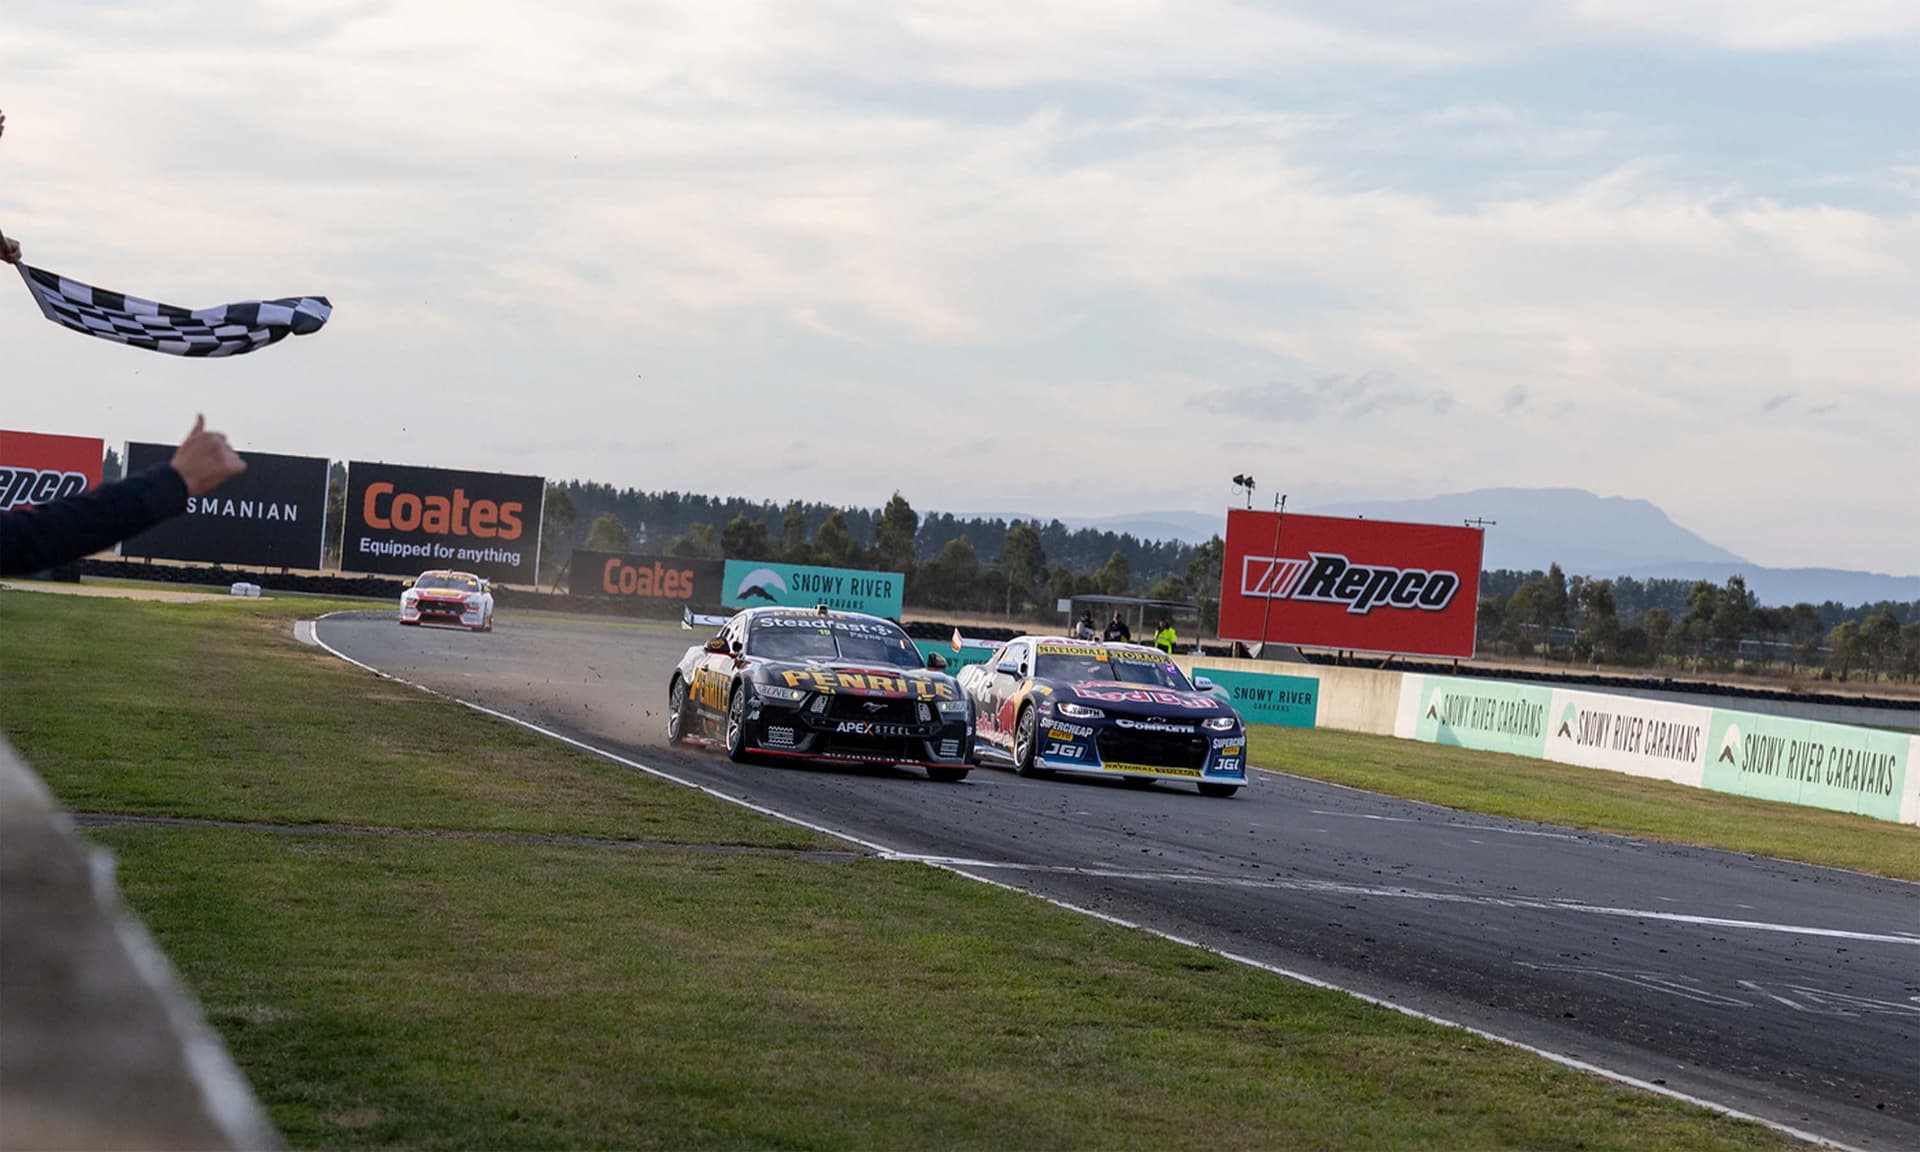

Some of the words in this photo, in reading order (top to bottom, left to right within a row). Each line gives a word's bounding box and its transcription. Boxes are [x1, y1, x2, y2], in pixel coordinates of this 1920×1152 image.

[363, 482, 523, 540] Coates
[360, 538, 431, 557] Equipped
[434, 544, 455, 559] for
[457, 548, 521, 566] anything
[603, 558, 694, 599] Coates
[792, 573, 844, 595] SNOWY
[850, 578, 892, 599] RIVER
[1294, 553, 1459, 612] Repco
[760, 617, 870, 633] Steadfast
[1039, 645, 1105, 657] NATIONAL
[689, 667, 729, 712] PENRITE
[781, 670, 954, 700] PENRITE
[1234, 687, 1273, 702] SNOWY
[1279, 691, 1312, 705] RIVER
[1254, 703, 1289, 712] CARAVANS
[1442, 694, 1471, 727] SNOWY
[1471, 697, 1497, 731] RIVER
[1497, 701, 1543, 737] CARAVANS
[836, 720, 873, 736] APEX
[875, 725, 911, 735] STEEL
[1040, 717, 1093, 738] SUPERCHEAP
[1577, 710, 1612, 748] SNOWY
[1612, 715, 1643, 754] RIVER
[1644, 720, 1700, 763] CARAVANS
[1045, 743, 1084, 758] JGI
[1214, 759, 1240, 770] JGI
[1743, 733, 1785, 776] SNOWY
[1786, 740, 1824, 784] RIVER
[1826, 746, 1895, 796] CARAVANS
